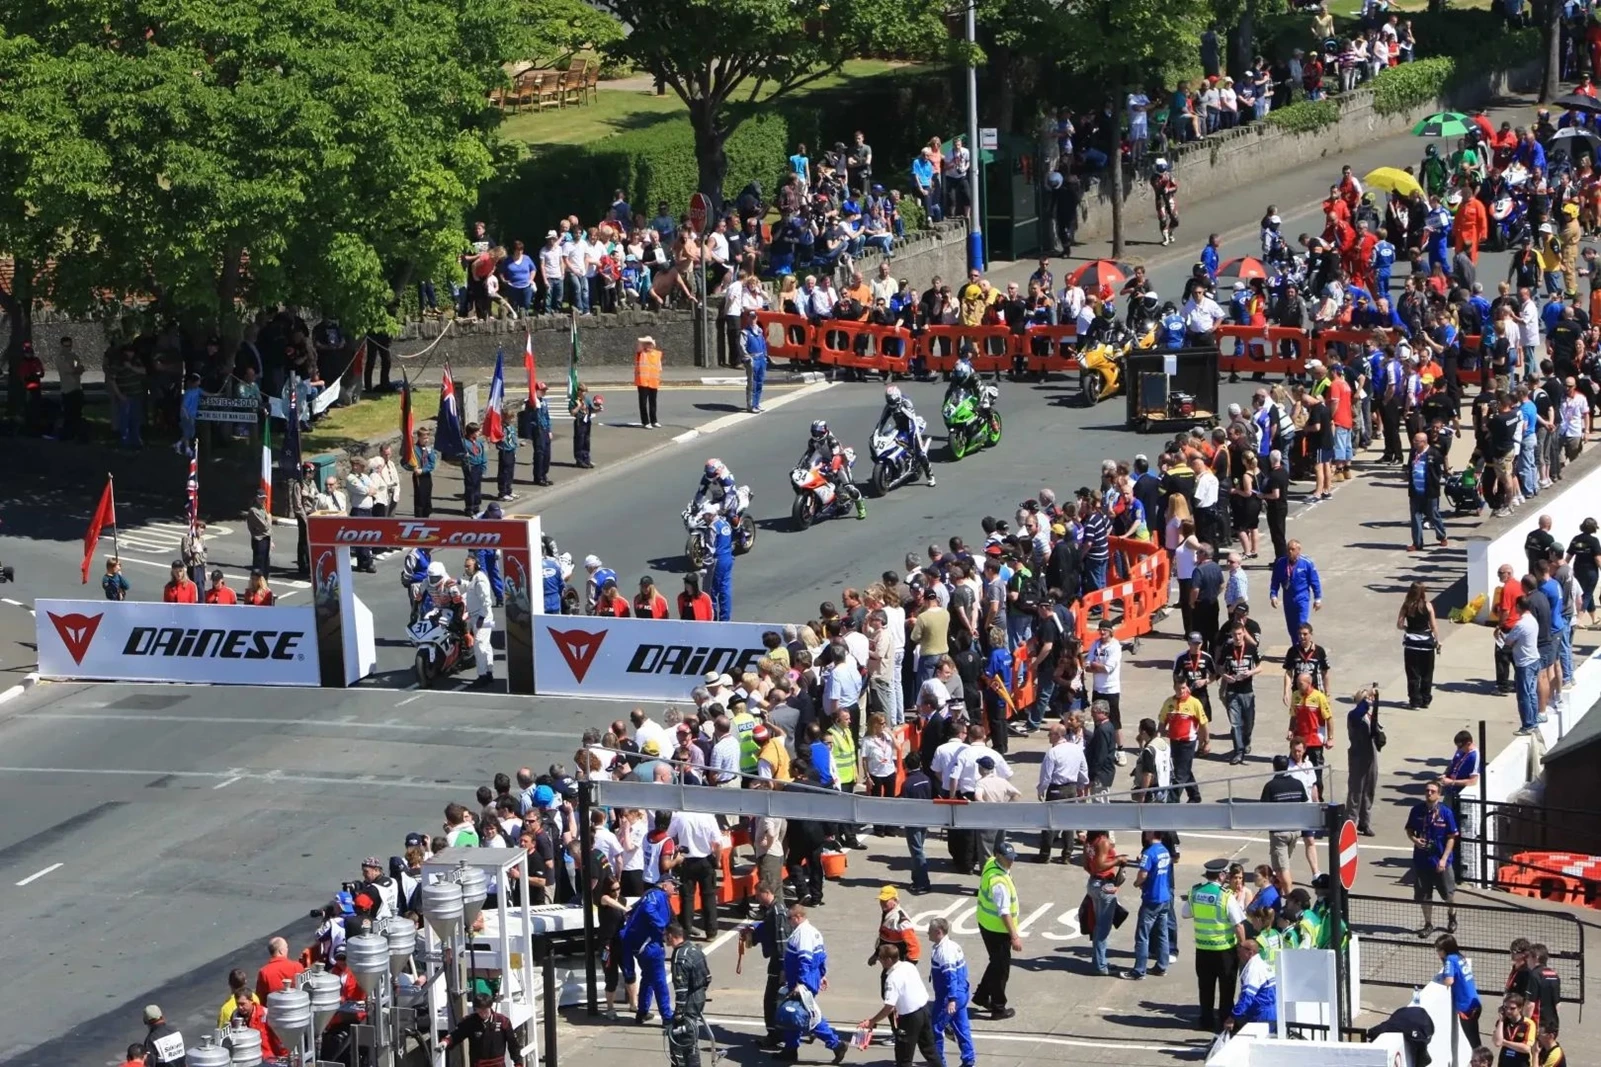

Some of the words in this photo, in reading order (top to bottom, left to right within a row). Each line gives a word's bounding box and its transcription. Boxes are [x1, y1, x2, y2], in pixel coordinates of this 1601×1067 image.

[795, 471, 808, 483] 34
[415, 623, 428, 633] 31
[122, 627, 304, 661] DAINESE
